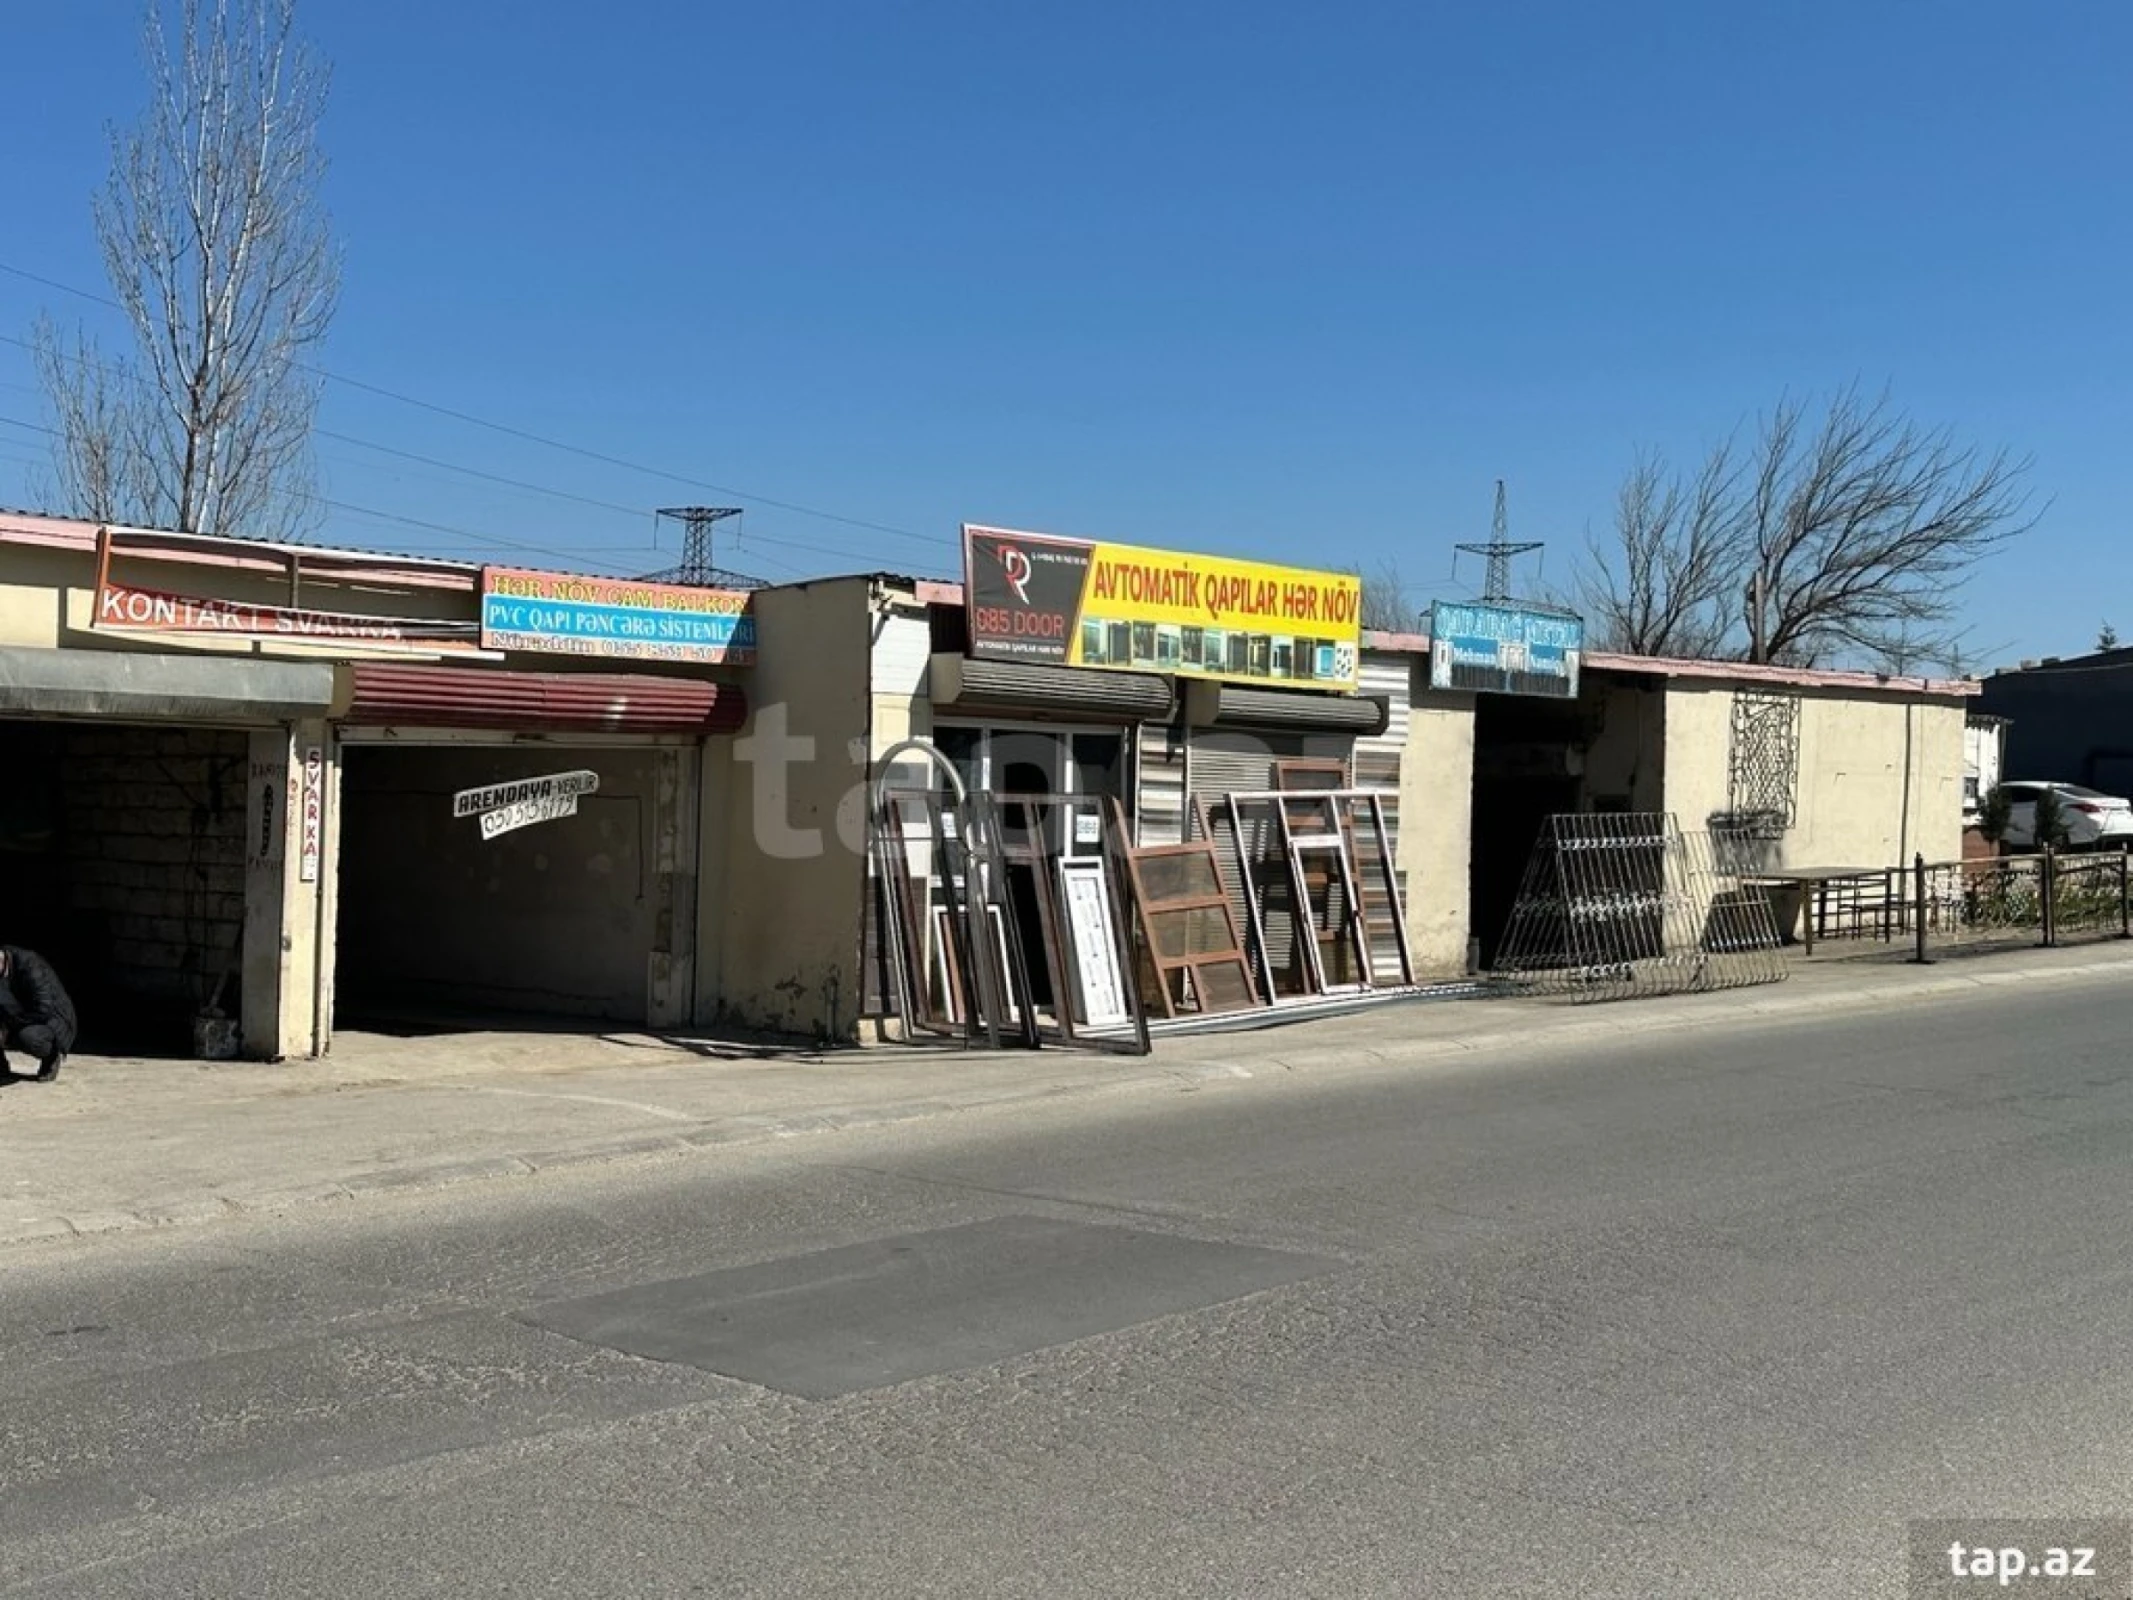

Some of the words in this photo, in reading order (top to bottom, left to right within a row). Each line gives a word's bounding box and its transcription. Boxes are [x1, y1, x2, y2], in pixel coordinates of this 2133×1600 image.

[102, 589, 266, 632] KONTAKT
[1093, 561, 1200, 608] AVTOMATİK
[1205, 575, 1278, 619] QAPILAR
[1282, 583, 1317, 621] HƏR
[1322, 581, 1358, 624] NÖV
[489, 604, 524, 626] PVC
[529, 608, 570, 631] QAPI
[576, 611, 656, 637] PƏNCƏRƏ
[1013, 611, 1065, 637] DOOR
